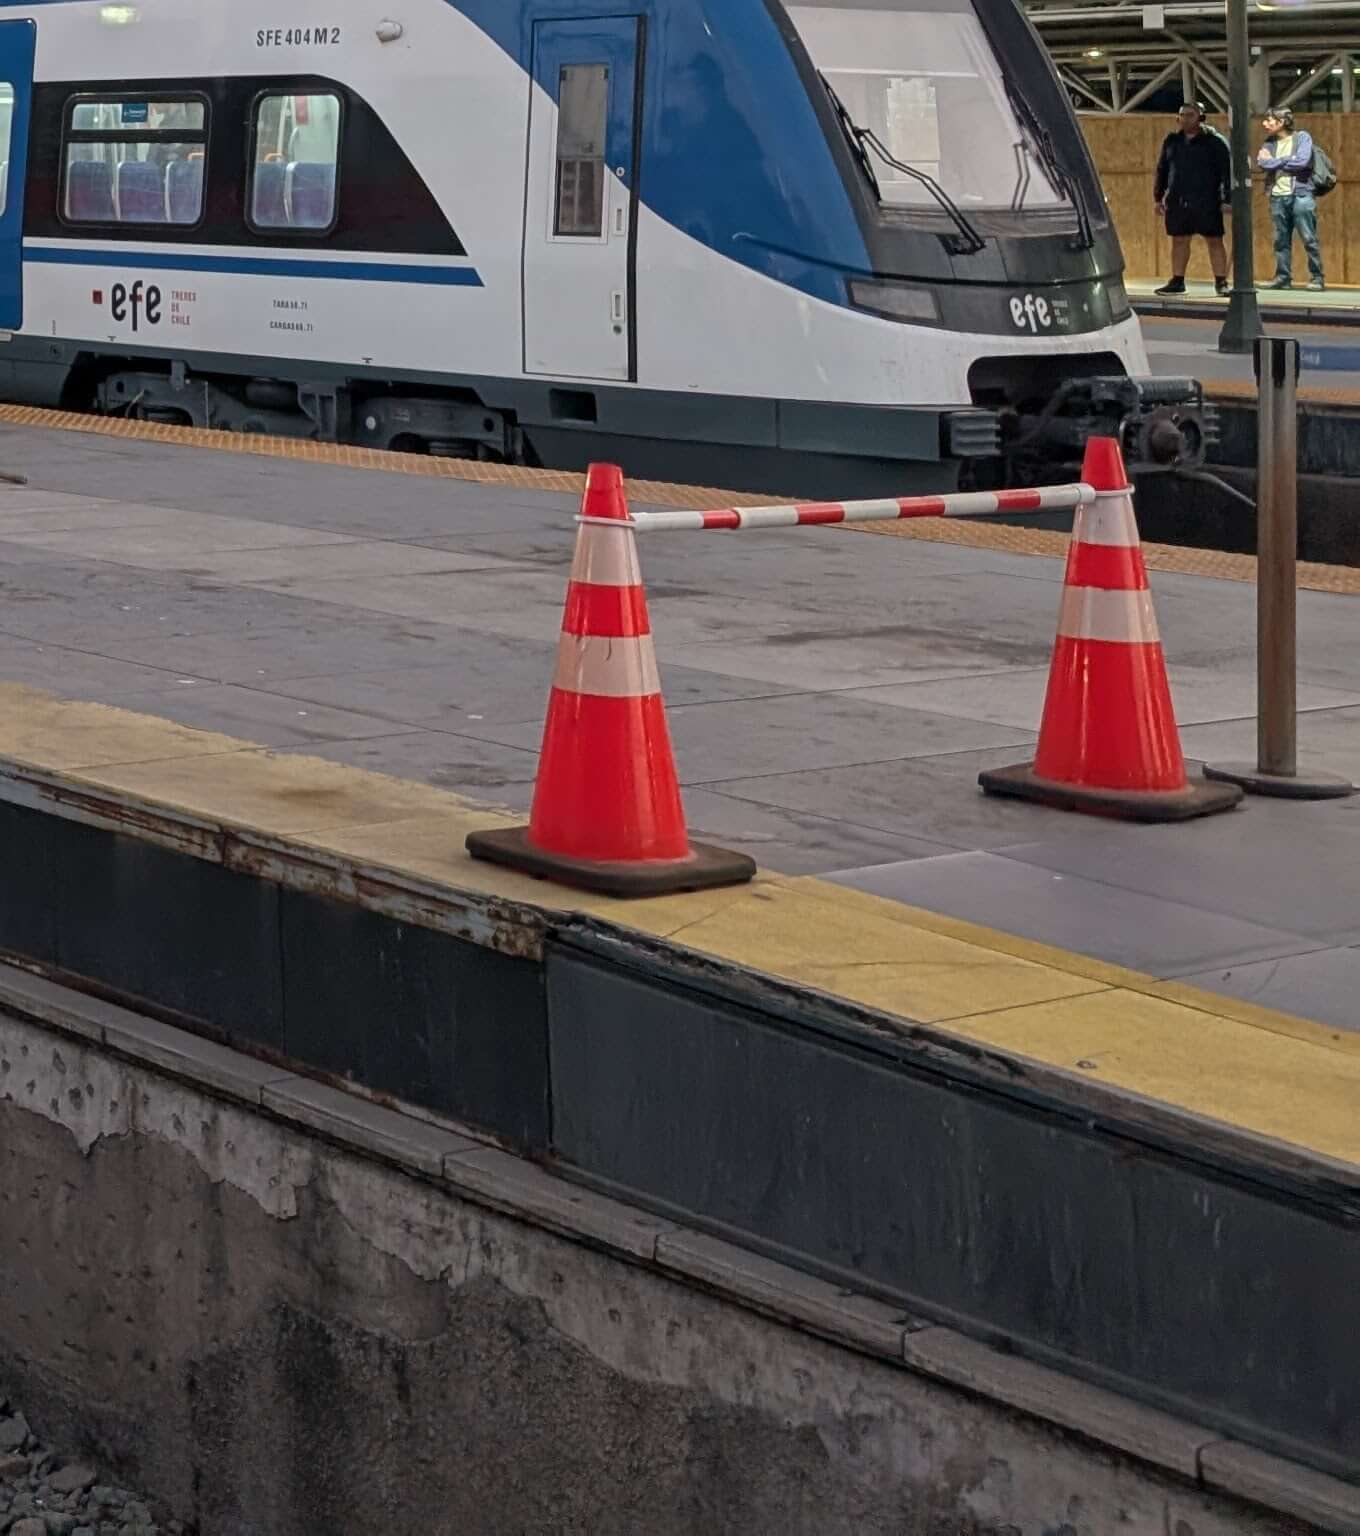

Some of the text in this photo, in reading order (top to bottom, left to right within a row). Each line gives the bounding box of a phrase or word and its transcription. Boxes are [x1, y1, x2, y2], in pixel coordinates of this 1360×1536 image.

[256, 29, 282, 47] SFE
[285, 28, 311, 45] 404
[112, 280, 161, 332] efe
[1010, 293, 1051, 333] efe
